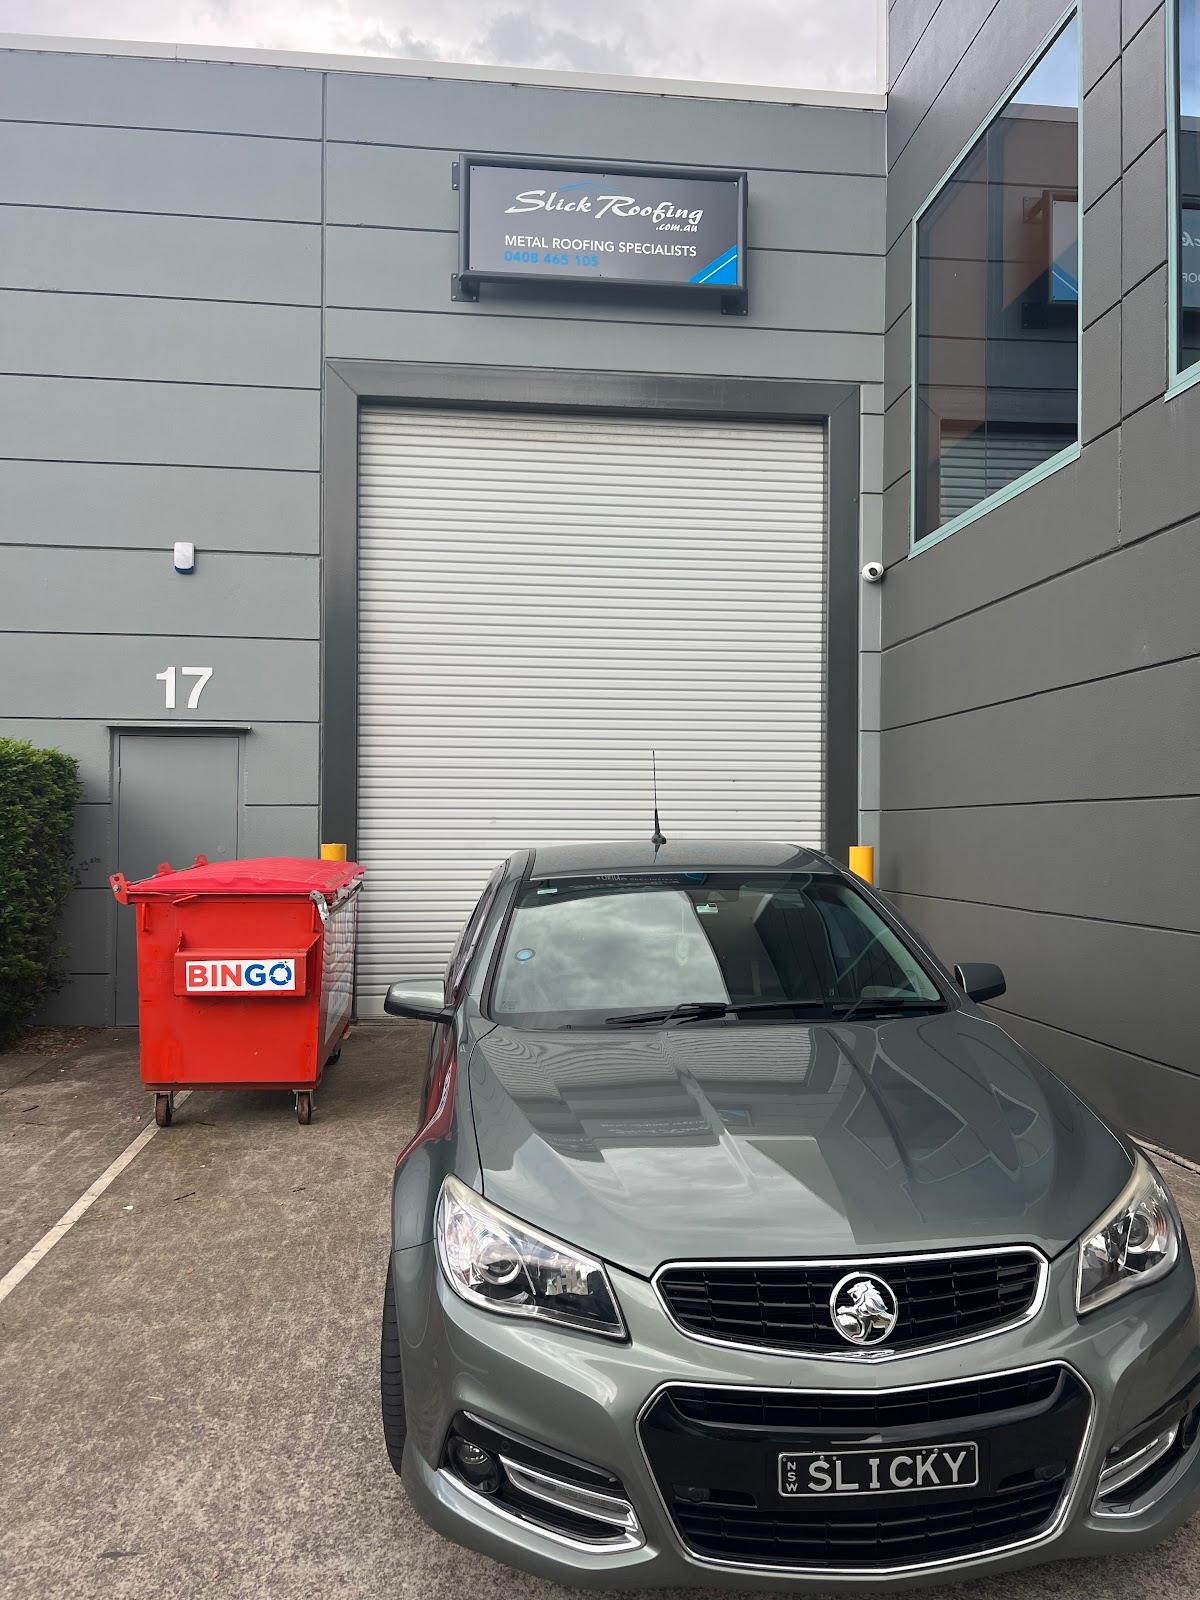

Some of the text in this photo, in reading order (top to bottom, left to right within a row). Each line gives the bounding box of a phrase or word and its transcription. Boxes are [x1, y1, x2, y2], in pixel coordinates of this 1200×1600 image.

[504, 189, 704, 224] Slick Roofing
[655, 222, 698, 233] .com.au
[504, 234, 697, 257] METAL ROOFING SPECIALISTS
[503, 250, 599, 267] 0408 465 105
[156, 666, 213, 709] 17
[188, 963, 293, 987] BINGO
[807, 1451, 967, 1492] SLICKY
